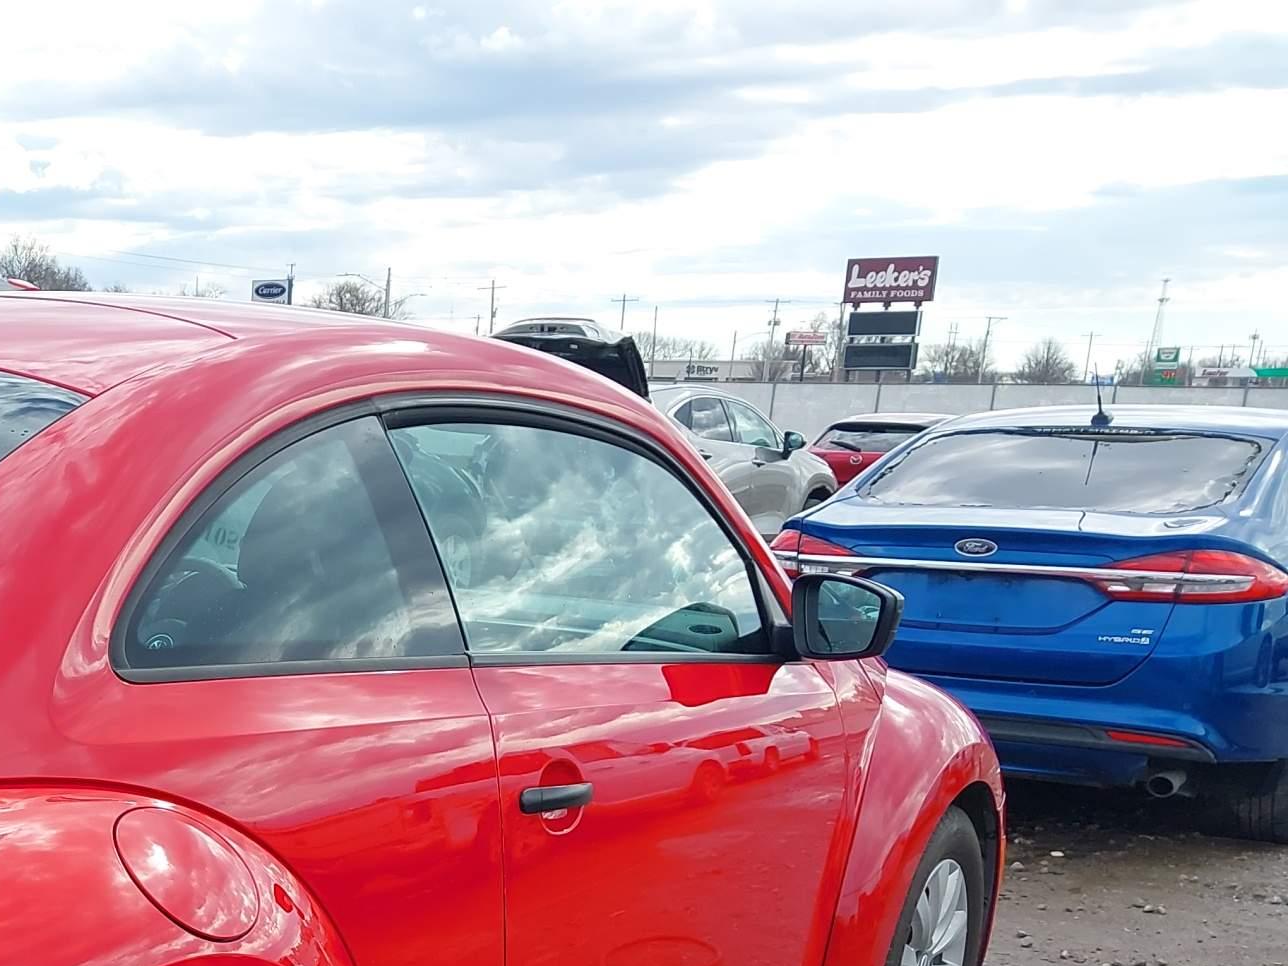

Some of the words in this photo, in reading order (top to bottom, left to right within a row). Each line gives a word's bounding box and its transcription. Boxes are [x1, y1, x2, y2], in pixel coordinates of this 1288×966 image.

[848, 263, 932, 288] Leeker's
[258, 286, 283, 295] Carrier
[850, 290, 887, 298] FAMILY
[890, 289, 924, 297] FOODS
[963, 541, 988, 552] Ford
